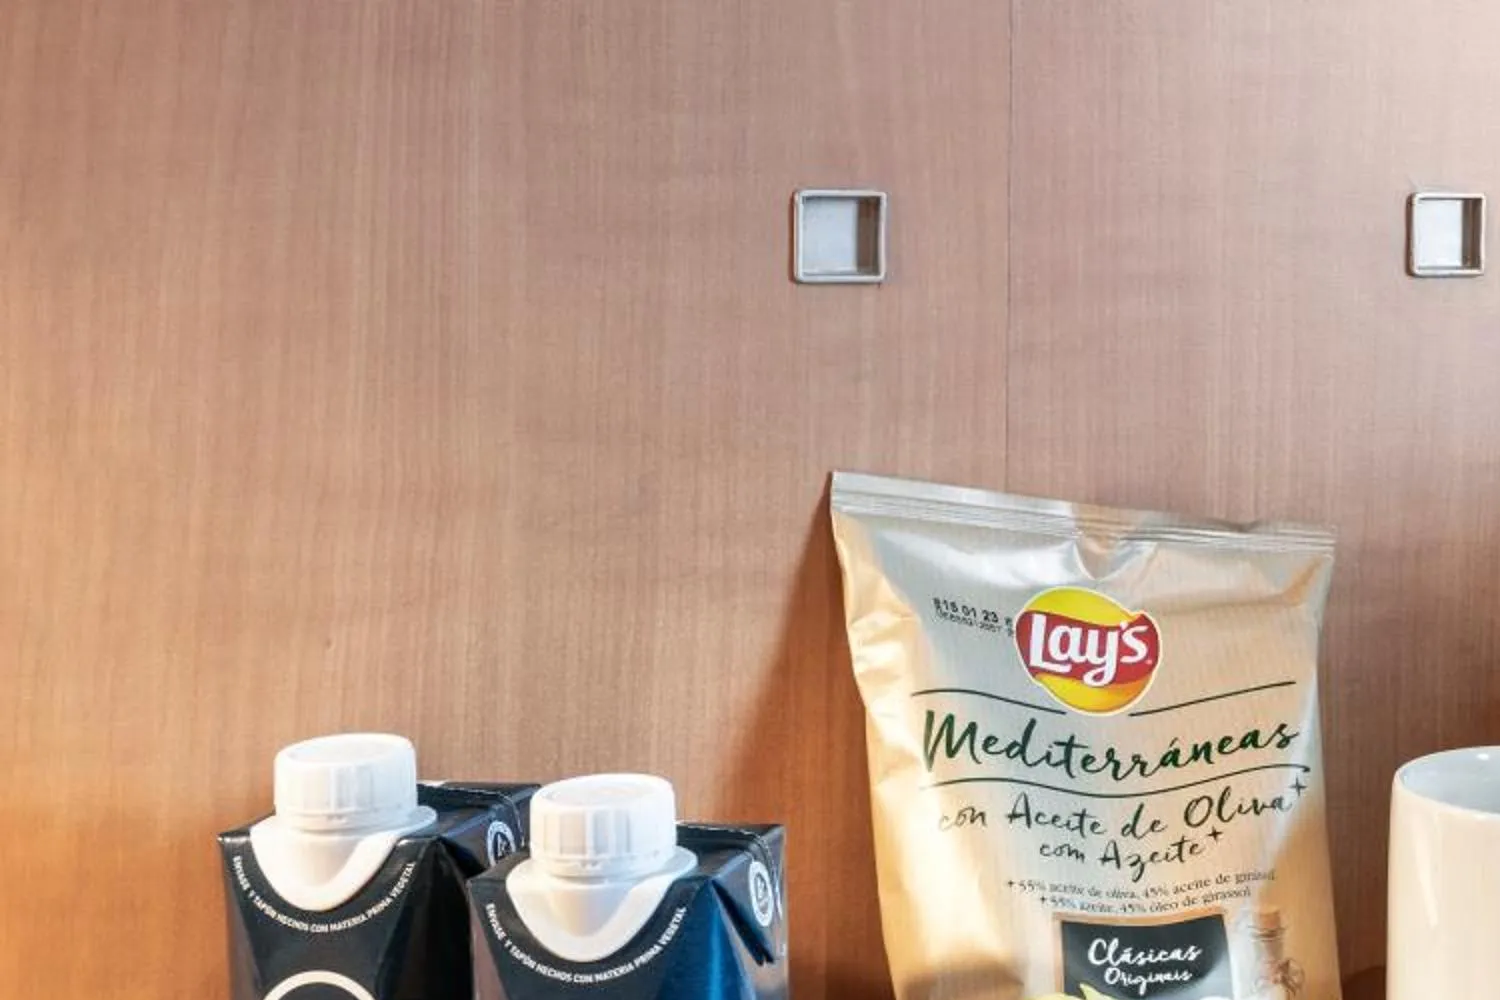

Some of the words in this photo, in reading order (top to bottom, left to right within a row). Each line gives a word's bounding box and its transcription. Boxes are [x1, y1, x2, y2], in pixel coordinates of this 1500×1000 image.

[982, 609, 999, 623] 23
[1029, 612, 1150, 687] Lay's
[922, 709, 1301, 782] Mediterráneas
[938, 806, 987, 831] con
[1007, 791, 1107, 840] Aceite
[1121, 807, 1166, 840] de
[1040, 841, 1085, 863] com
[1173, 878, 1211, 894] aceite
[1215, 873, 1231, 884] de
[1183, 896, 1199, 907] de
[310, 923, 329, 933] CON
[485, 903, 506, 941] ENVASE
[535, 962, 572, 982] HECHOS
[573, 974, 593, 983] CON
[595, 963, 635, 982] MATERIA
[634, 944, 662, 968] PRIMA
[658, 906, 687, 946] VEGETAL
[1087, 938, 1203, 968] Clásicas
[1104, 967, 1193, 996] Originais
